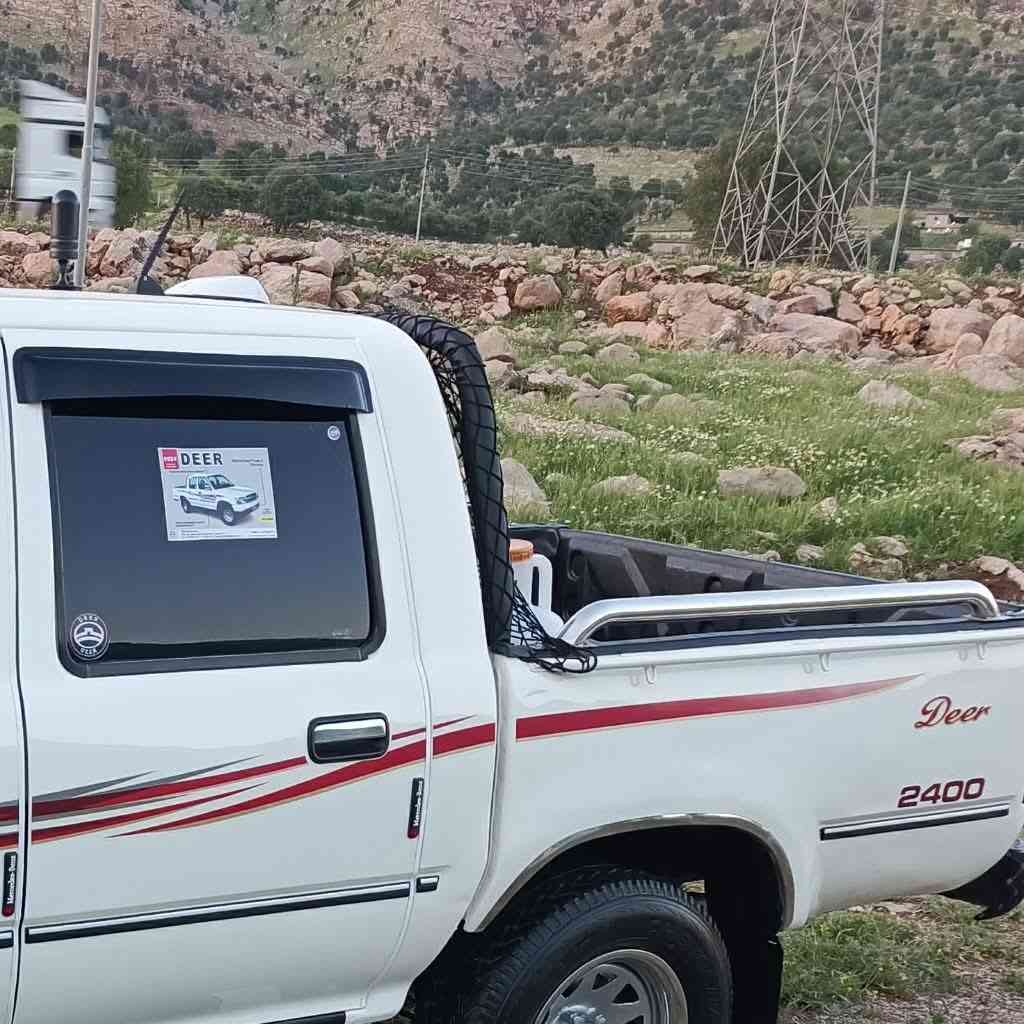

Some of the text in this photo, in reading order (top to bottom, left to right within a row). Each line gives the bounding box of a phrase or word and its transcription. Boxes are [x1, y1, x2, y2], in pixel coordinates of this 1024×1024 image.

[180, 452, 223, 466] DEER
[914, 695, 991, 729] Deer
[897, 777, 986, 809] 2400
